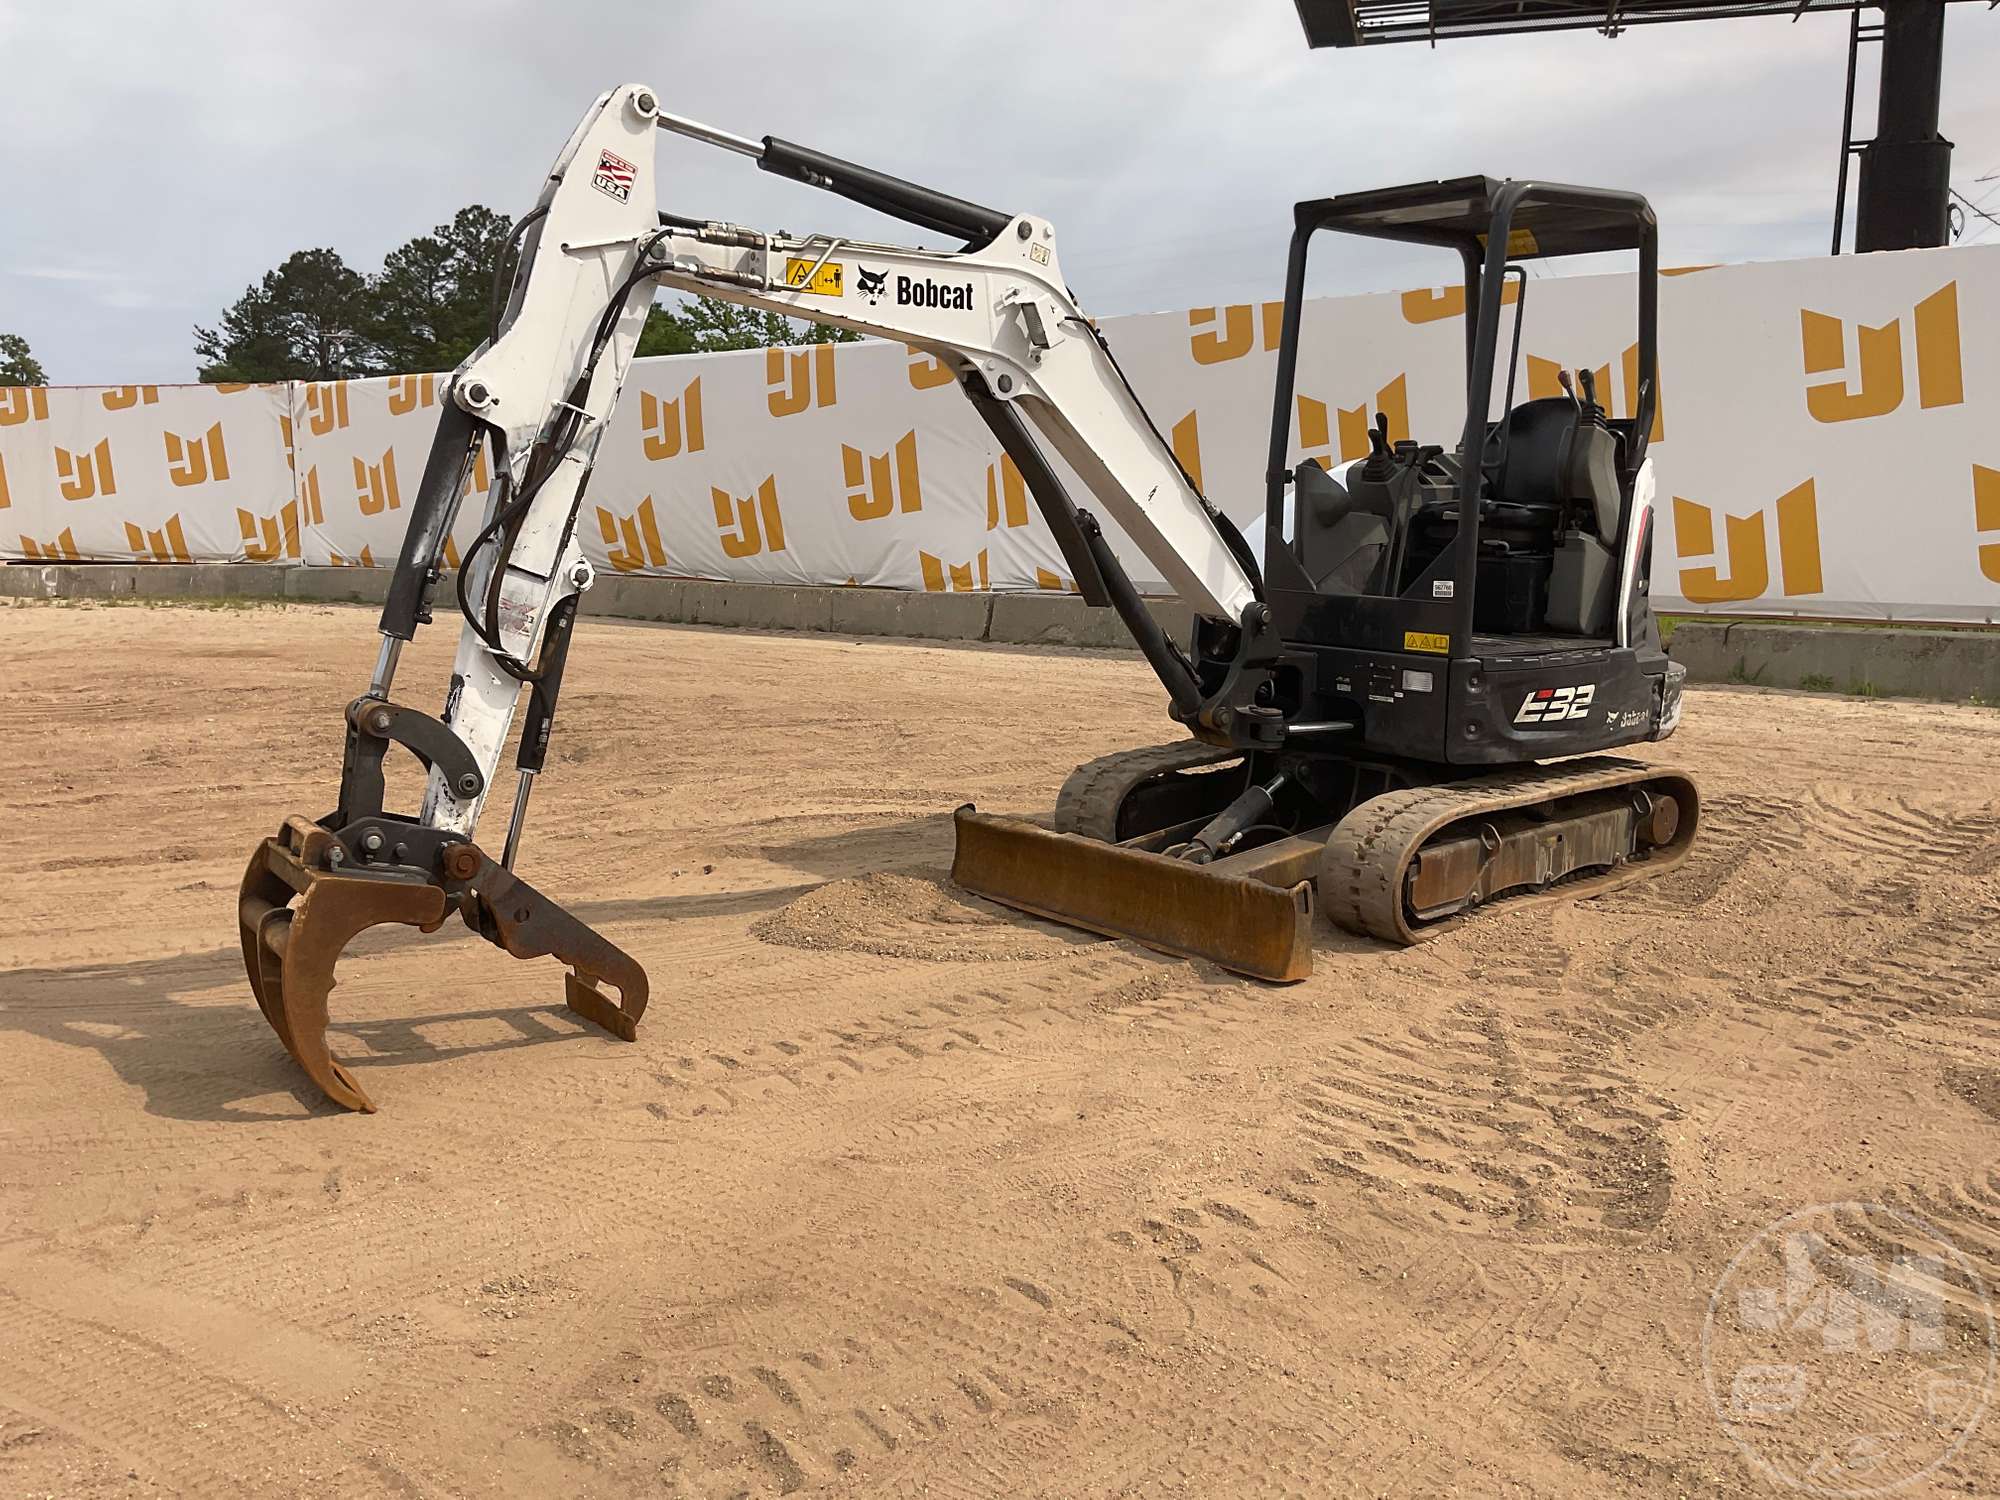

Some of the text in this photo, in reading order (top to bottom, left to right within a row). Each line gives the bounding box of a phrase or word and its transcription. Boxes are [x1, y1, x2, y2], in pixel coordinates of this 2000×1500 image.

[595, 175, 626, 199] USA
[897, 275, 973, 312] Bobcat
[1513, 684, 1596, 724] E32
